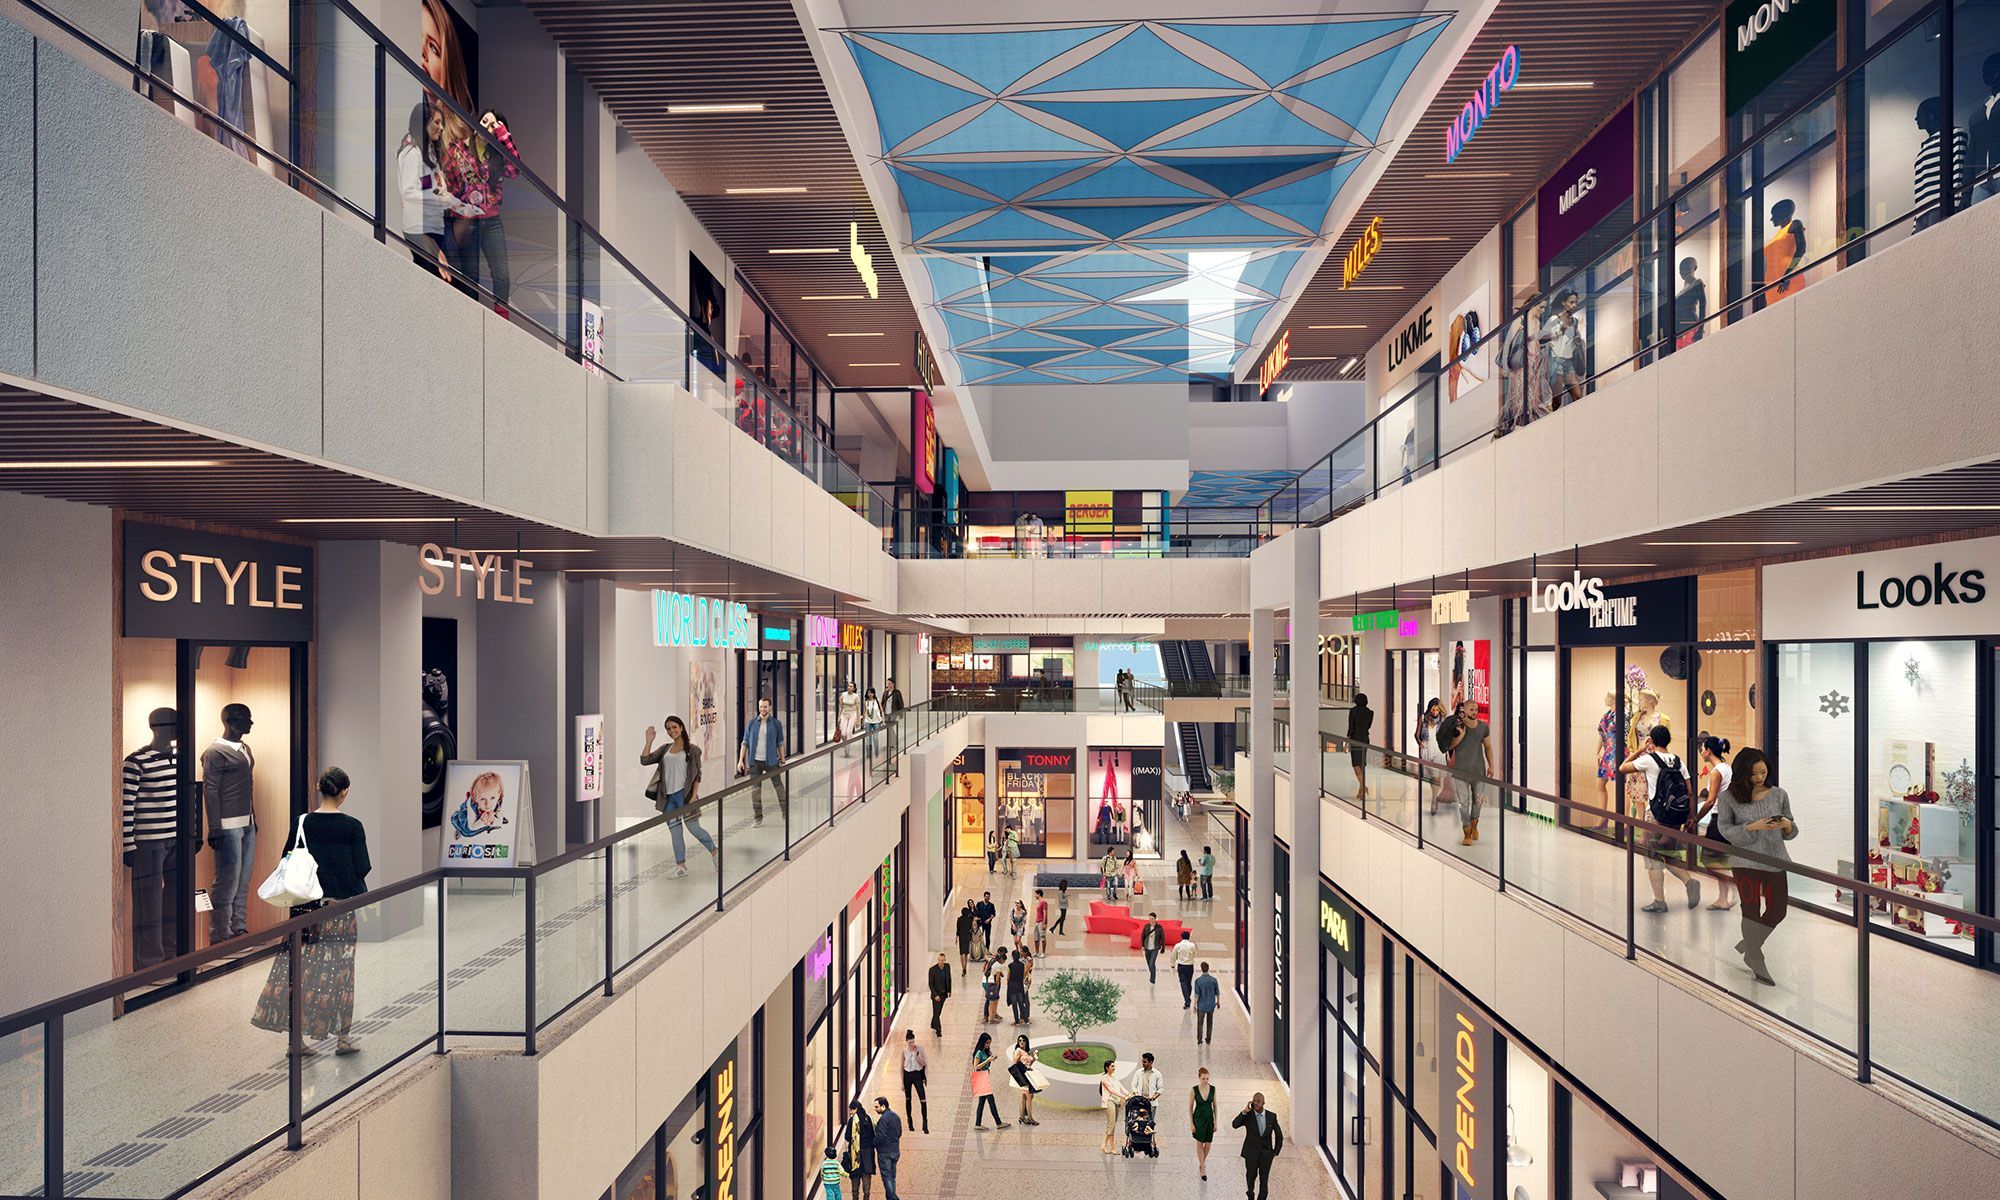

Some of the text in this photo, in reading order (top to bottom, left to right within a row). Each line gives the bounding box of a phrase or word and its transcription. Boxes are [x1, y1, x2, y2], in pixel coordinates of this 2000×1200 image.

[1737, 0, 1799, 52] MON
[1446, 45, 1520, 164] MONTO
[1559, 168, 1597, 215] MILES
[1343, 216, 1383, 290] MILES
[1260, 327, 1291, 397] LUKME
[1389, 306, 1433, 373] LUKME
[1069, 503, 1110, 518] BERGER
[139, 549, 304, 610] STYLE
[418, 542, 534, 606] STYLE
[1532, 570, 1605, 613] Looks
[1857, 562, 1986, 610] Looks
[653, 589, 749, 649] WORLD CLASS
[843, 623, 864, 651] MILES
[1589, 596, 1637, 629] PERFUME
[1084, 640, 1152, 651] GALAXY COFFEE
[1007, 772, 1040, 780] BLACK
[1007, 780, 1040, 788] FRIDAY
[1026, 755, 1071, 767] TONNY
[1321, 899, 1349, 952] PARA
[1456, 1012, 1475, 1188] PENDI
